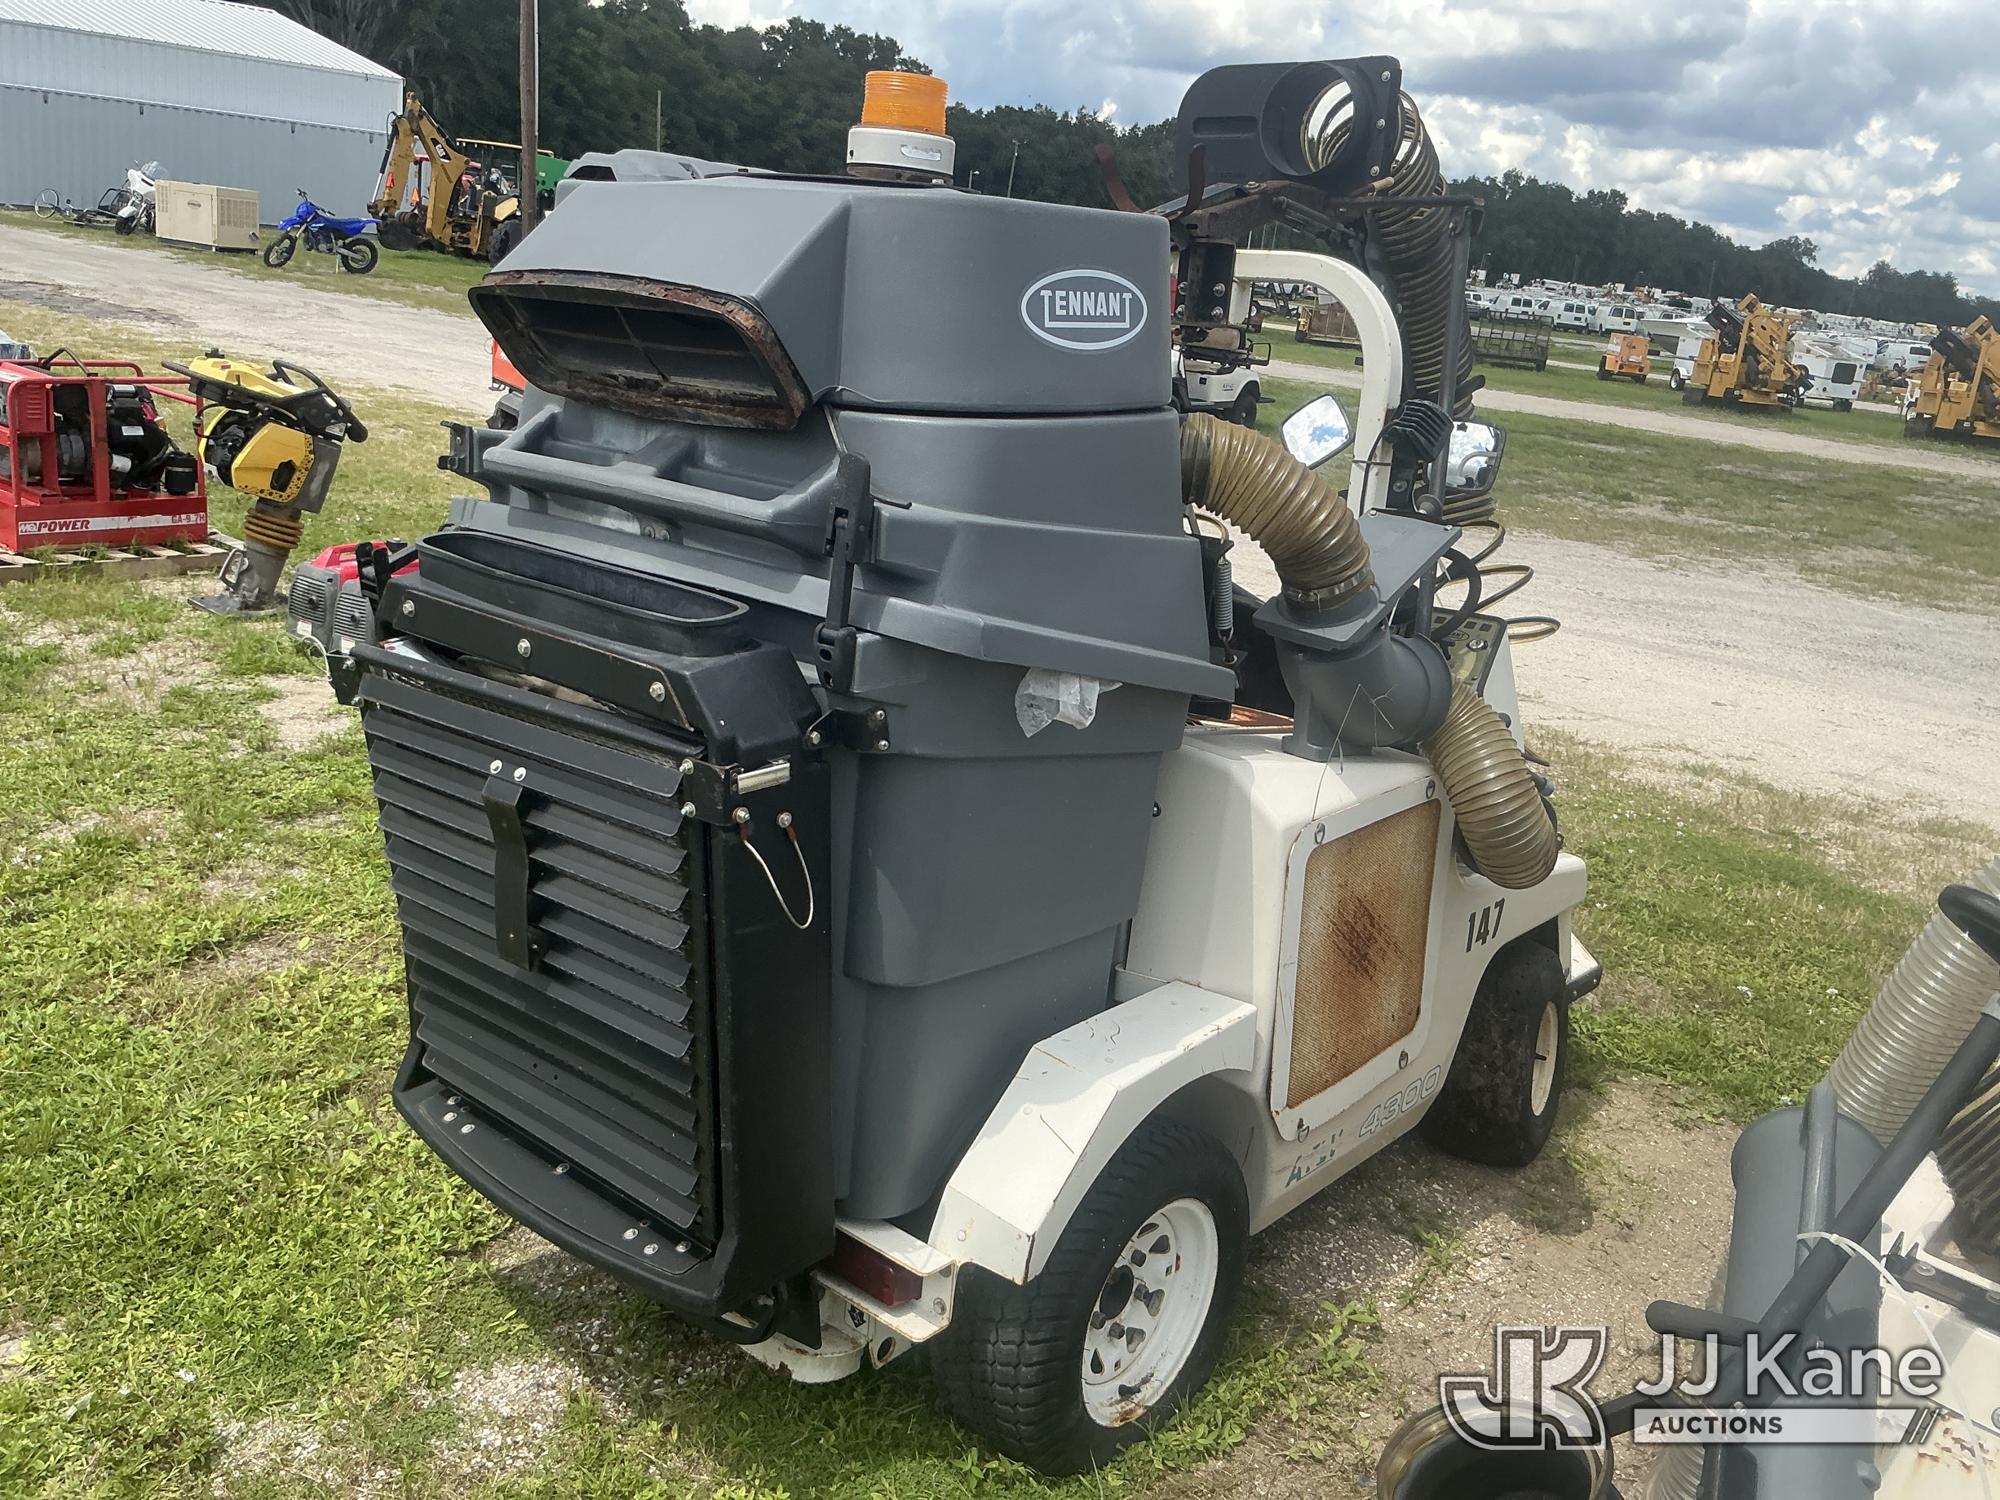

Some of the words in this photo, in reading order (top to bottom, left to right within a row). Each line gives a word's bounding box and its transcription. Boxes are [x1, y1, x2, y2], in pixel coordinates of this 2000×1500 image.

[1040, 289, 1132, 328] TENNANT
[1466, 897, 1505, 953] 147
[1358, 1064, 1442, 1138] 4300
